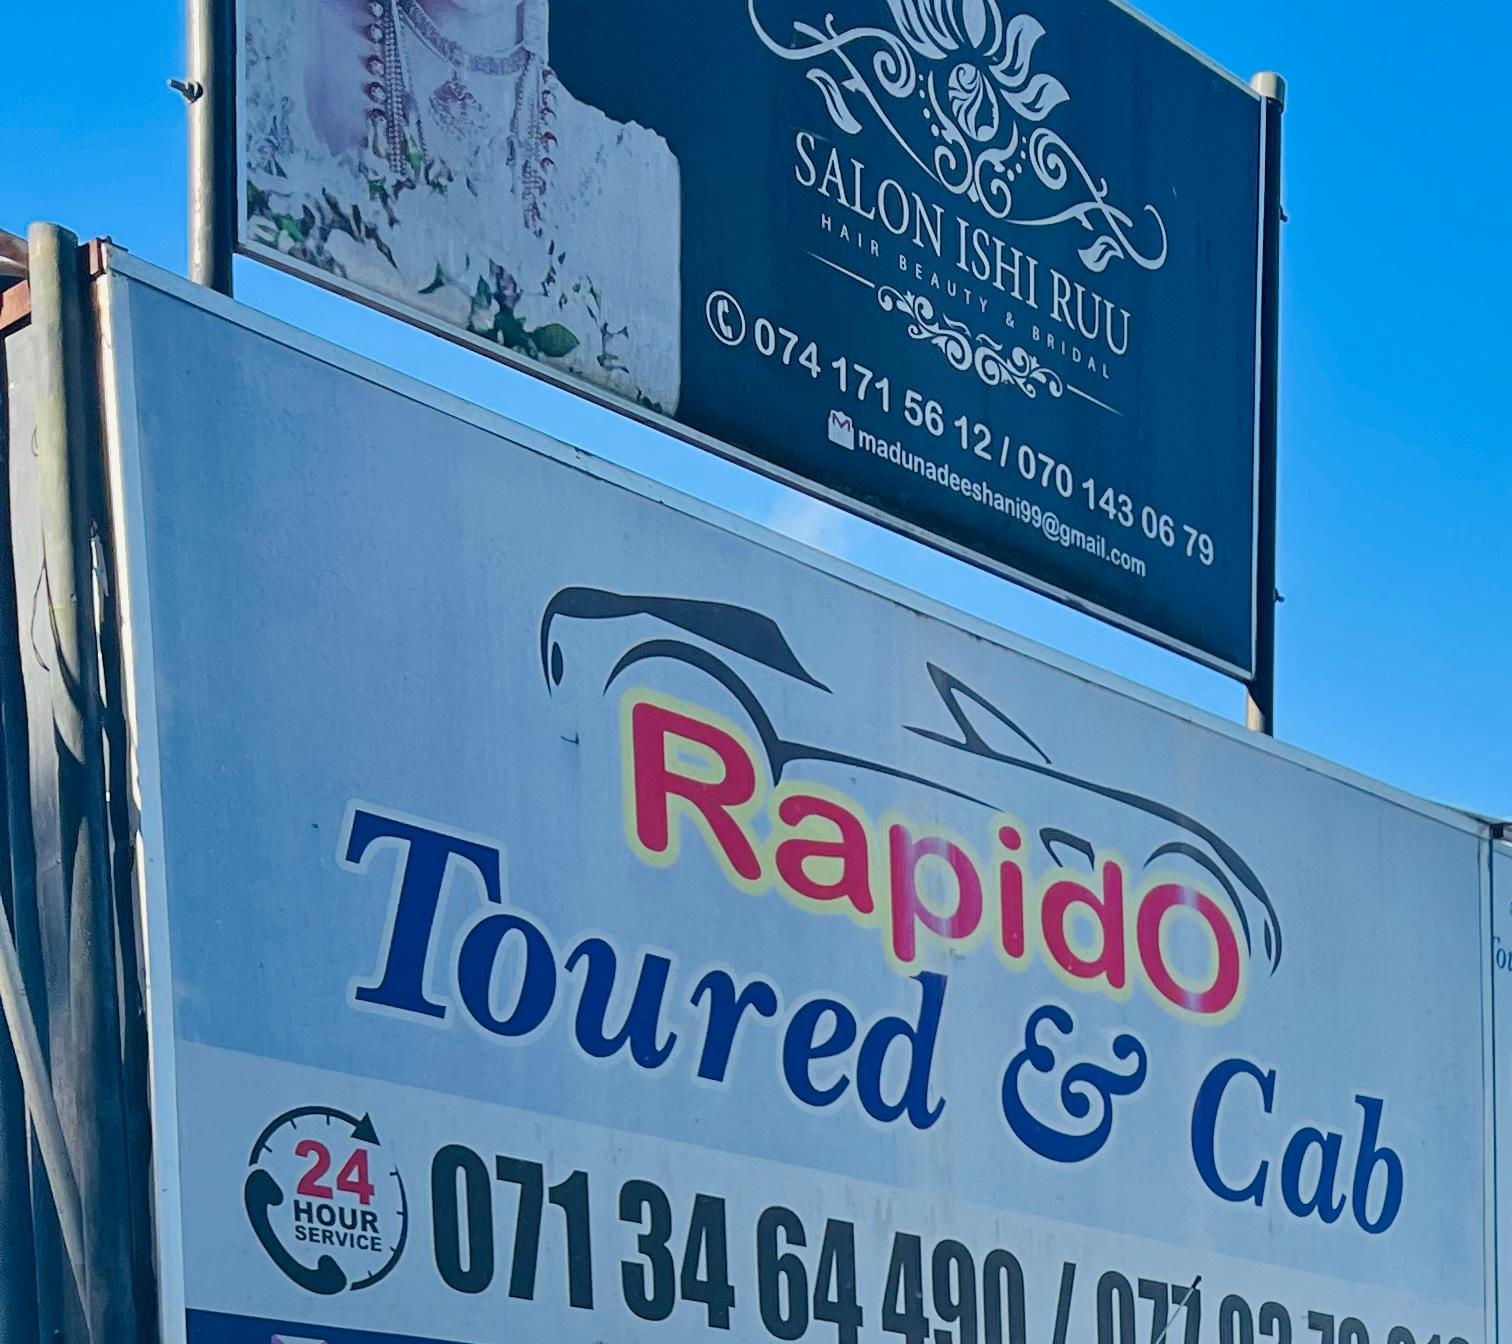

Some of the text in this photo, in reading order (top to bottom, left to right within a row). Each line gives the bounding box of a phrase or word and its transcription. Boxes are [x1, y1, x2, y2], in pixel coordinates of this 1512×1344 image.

[794, 132, 1131, 355] SALON ISHI RUU
[820, 214, 1110, 379] HAIR BEAUTY & BRIDAL
[754, 318, 821, 378] 074
[831, 359, 892, 412] 171
[904, 390, 944, 436] 56
[954, 415, 992, 460] 12
[1018, 445, 1073, 498] 070
[1082, 478, 1133, 528] 143
[1141, 506, 1175, 548] 06
[1183, 524, 1215, 566] 79
[858, 427, 1146, 577] madunadeeshani99@gmail.com
[345, 809, 1404, 1235] Toured & Cab
[293, 1199, 379, 1234] HOUR
[295, 1139, 375, 1206] 24
[295, 1225, 382, 1252] SERVICE
[430, 1143, 594, 1310] 071
[618, 1178, 735, 1330] 34
